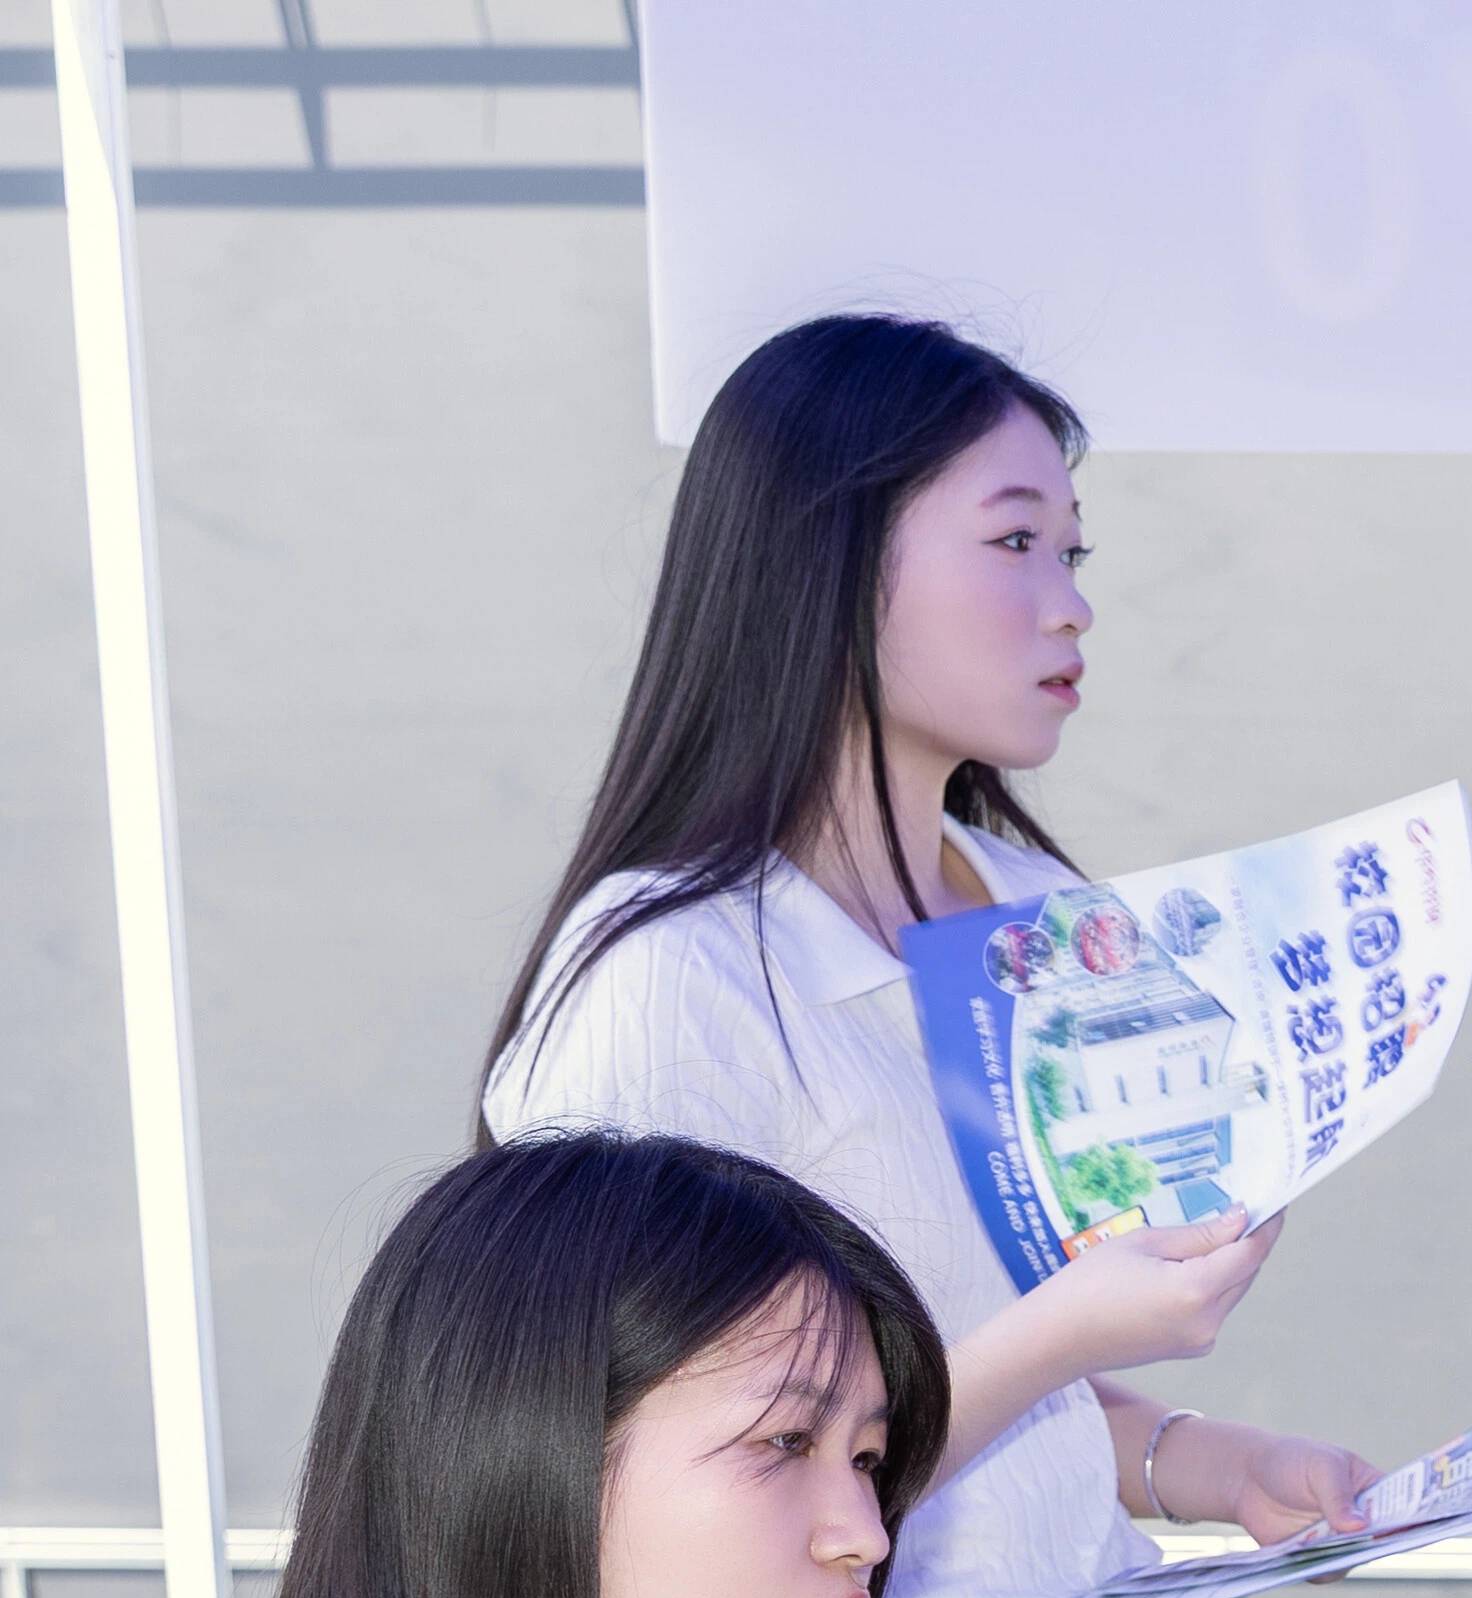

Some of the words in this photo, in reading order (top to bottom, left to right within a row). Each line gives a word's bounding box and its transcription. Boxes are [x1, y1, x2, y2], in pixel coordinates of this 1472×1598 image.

[1271, 931, 1346, 1175] 梦想起航
[1335, 841, 1404, 1087] 校园招聘
